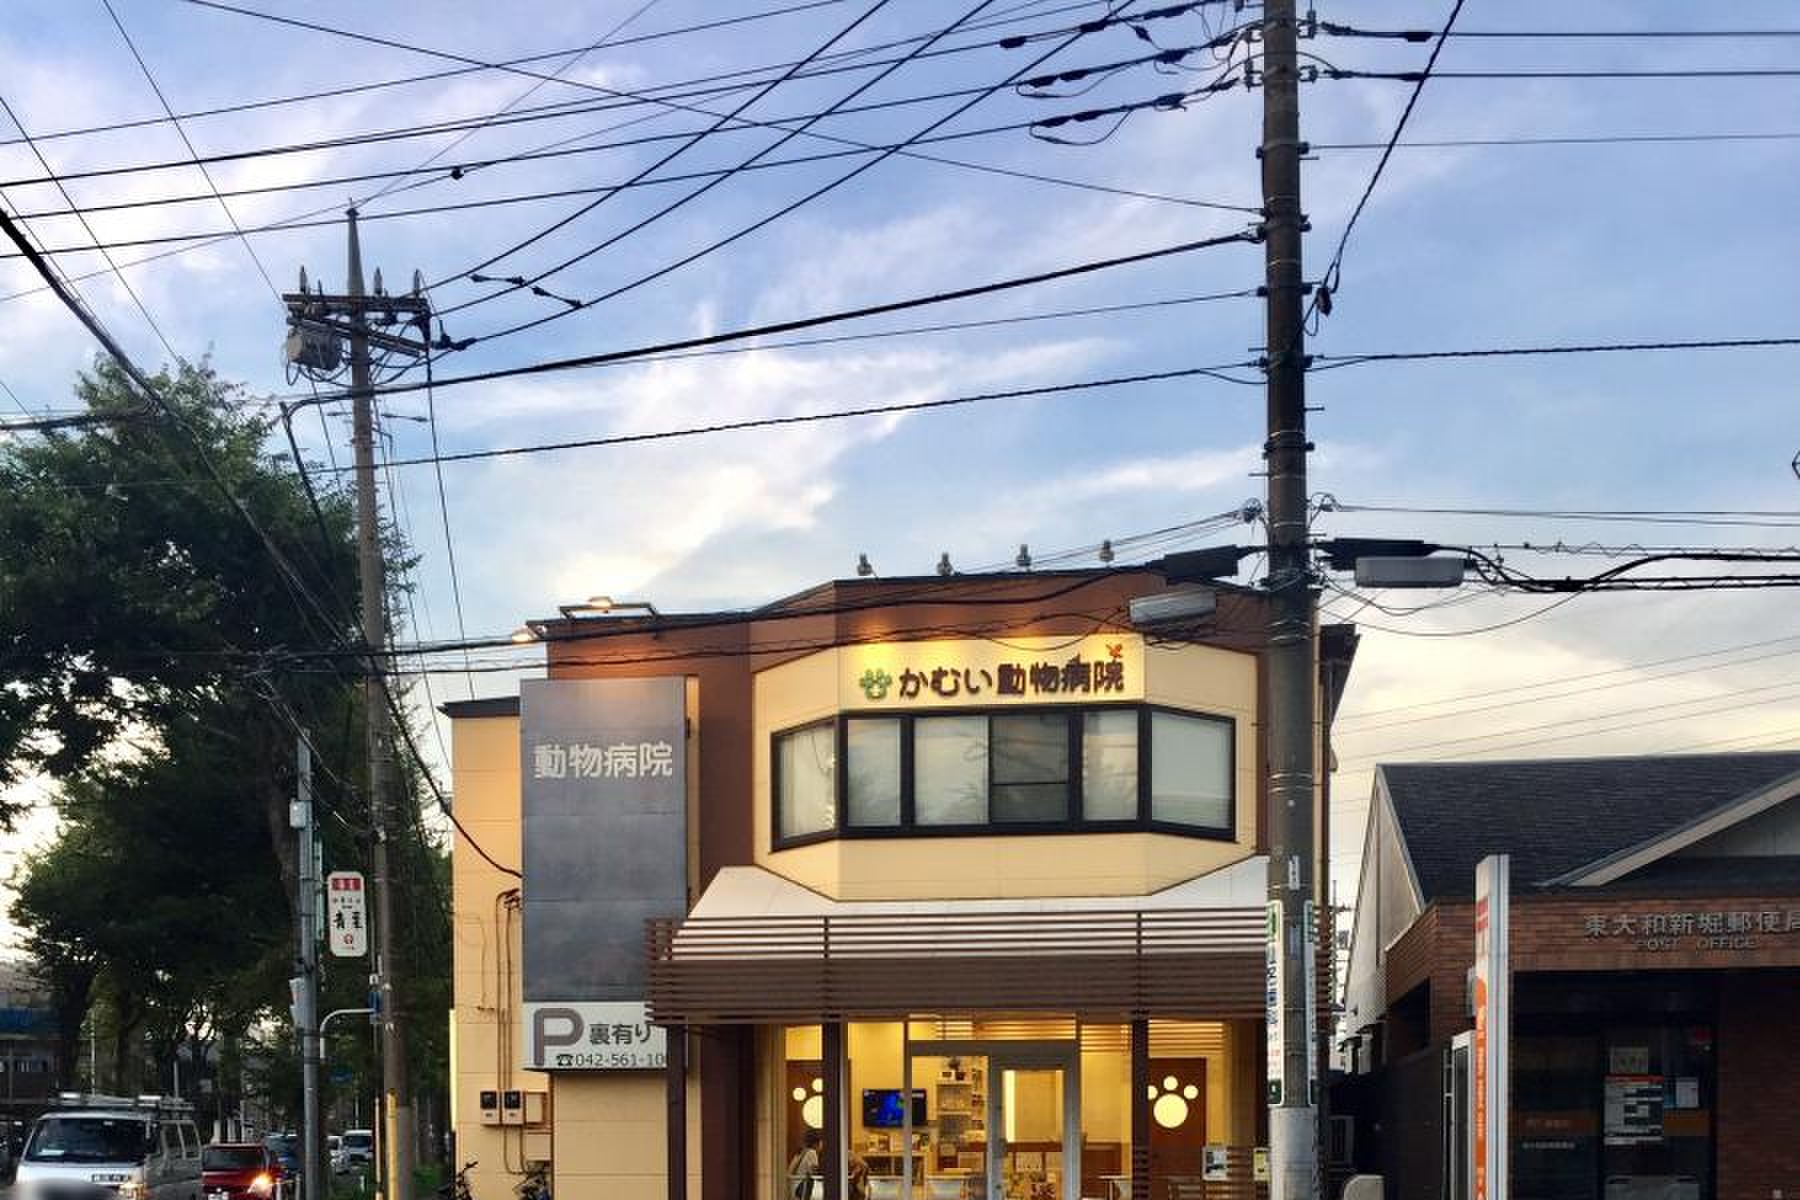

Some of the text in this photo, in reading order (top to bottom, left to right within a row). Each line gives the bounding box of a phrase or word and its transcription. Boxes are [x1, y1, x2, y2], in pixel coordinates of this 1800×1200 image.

[899, 660, 1124, 697] かむい動物病院
[534, 741, 673, 778] 動物病院
[1697, 937, 1757, 950] OFFICE
[534, 1007, 584, 1066] P
[589, 1023, 651, 1045] 裏有り
